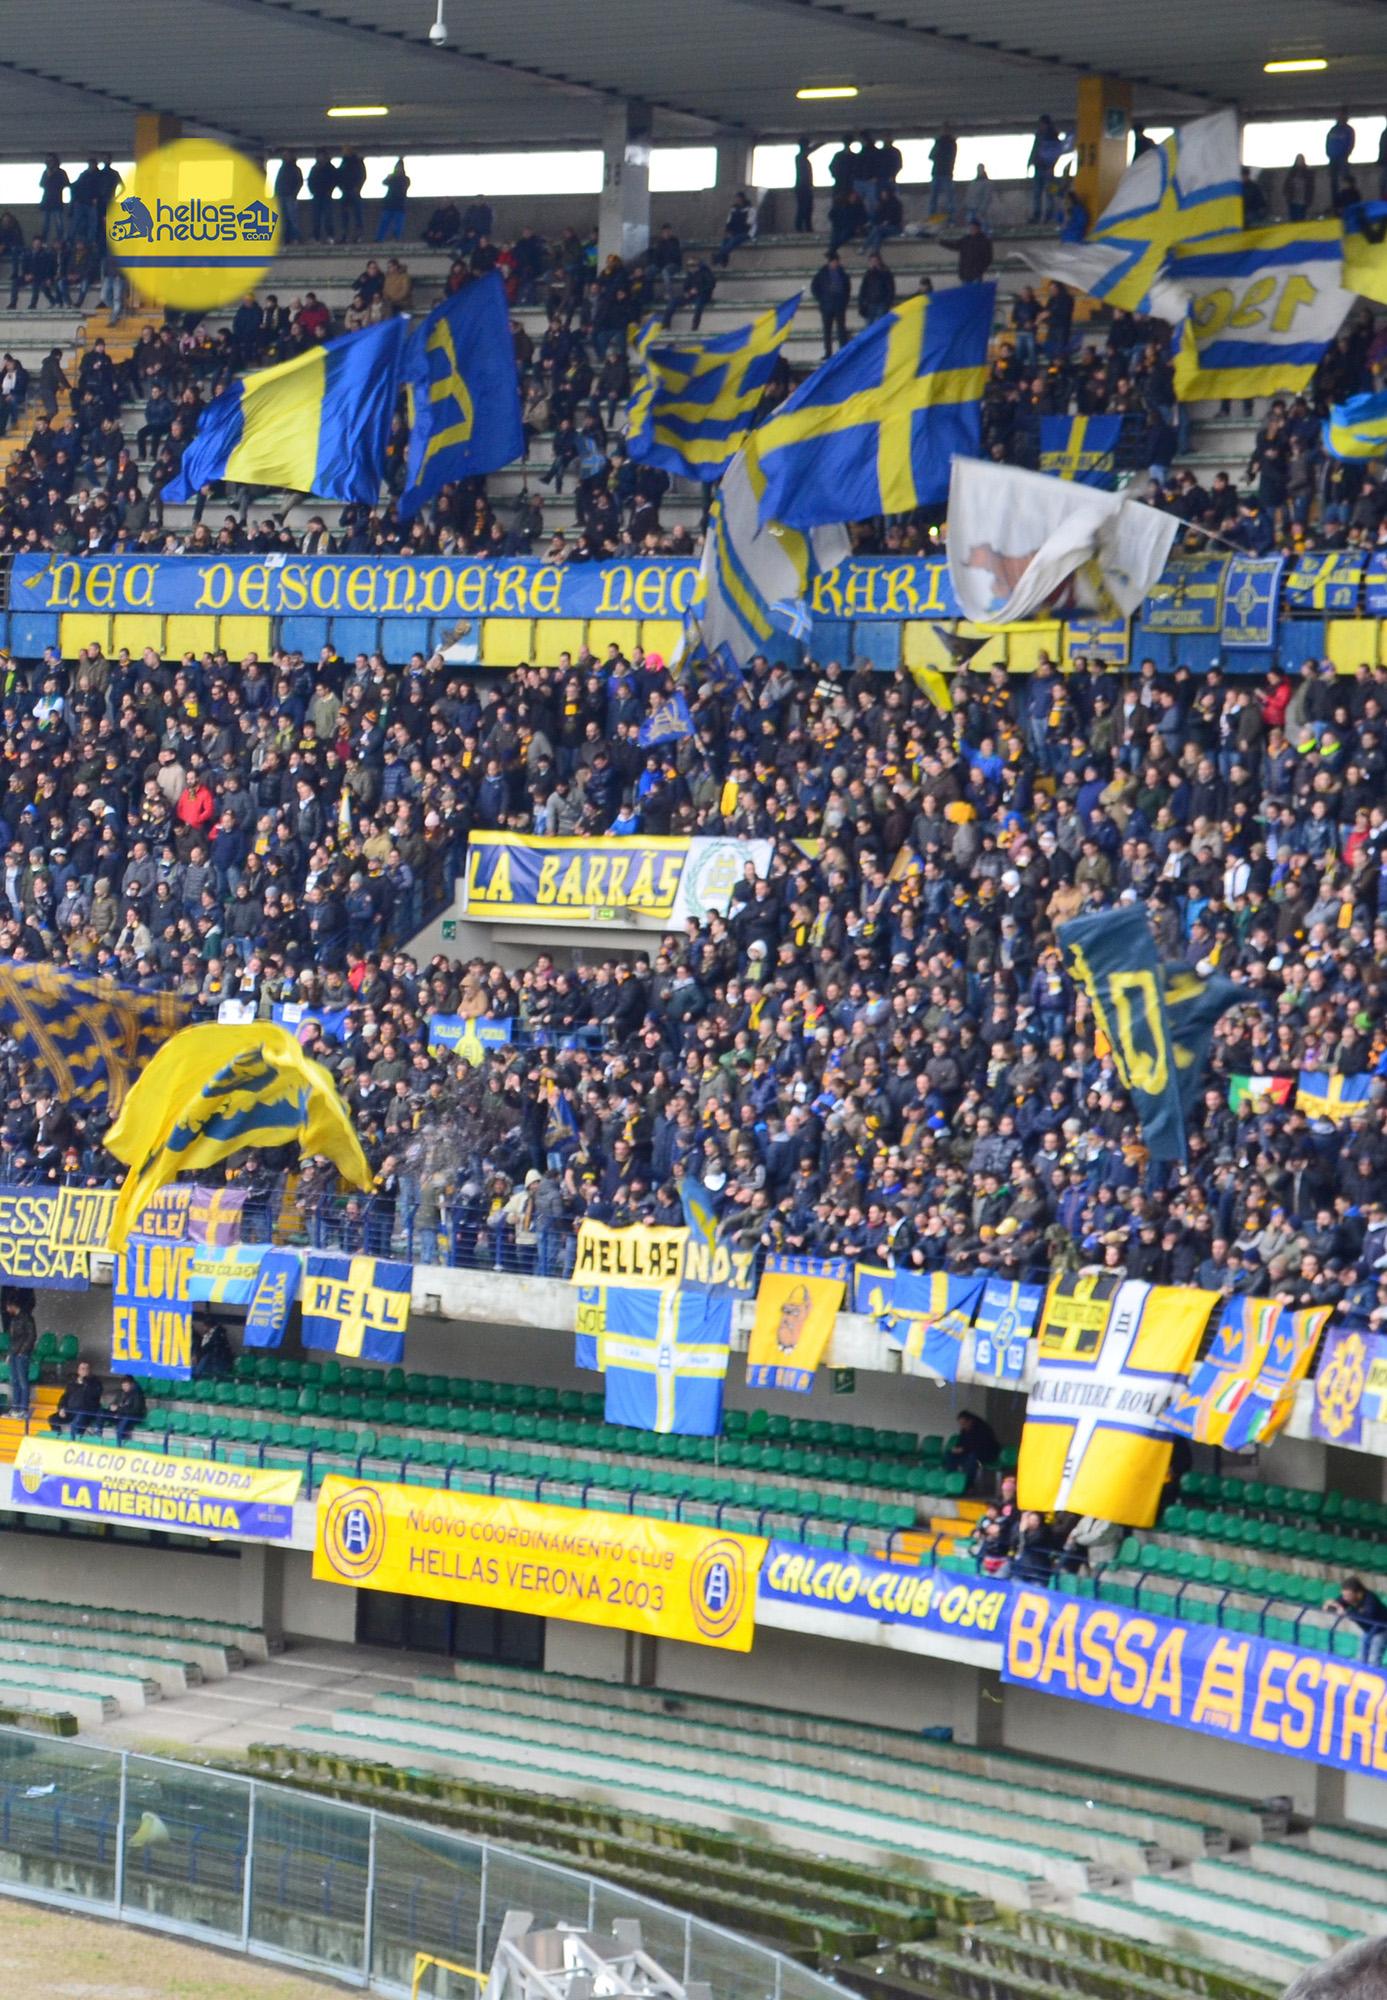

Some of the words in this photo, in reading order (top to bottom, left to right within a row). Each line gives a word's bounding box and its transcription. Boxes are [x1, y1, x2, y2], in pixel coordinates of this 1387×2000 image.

[469, 851, 513, 901] LA
[134, 1245, 195, 1302] LOVE
[580, 1235, 678, 1276] HELLAS
[314, 1284, 400, 1325] HELL
[113, 1306, 142, 1361] EL
[149, 1309, 192, 1367] VIN
[63, 1447, 126, 1471] CALCIO
[130, 1457, 176, 1478] CLUB
[61, 1483, 92, 1510] LA
[98, 1489, 241, 1530] MERIDIANA
[406, 1509, 466, 1539] NUOVO
[470, 1521, 624, 1561] COORDINAMENTO
[627, 1545, 676, 1571] CLUB
[408, 1546, 500, 1585] HELLAS
[506, 1560, 602, 1601] VERONA
[606, 1576, 665, 1612] 2003
[1008, 1591, 1188, 1718] BASSA
